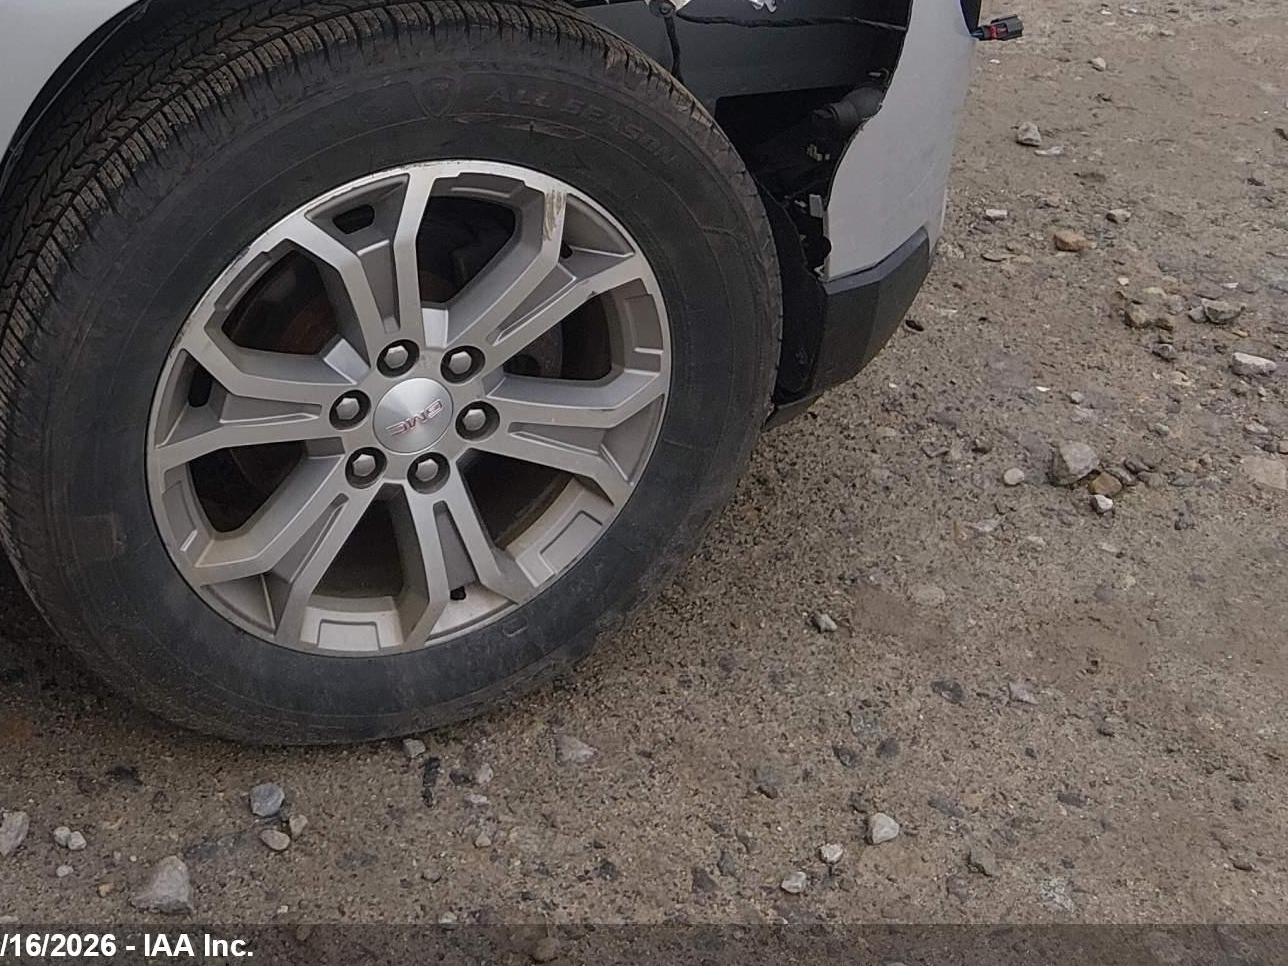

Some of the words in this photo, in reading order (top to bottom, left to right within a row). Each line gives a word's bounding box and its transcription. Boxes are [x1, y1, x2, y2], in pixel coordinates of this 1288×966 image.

[486, 86, 550, 108] ALL
[560, 97, 677, 165] SEASON
[385, 398, 443, 437] GMC
